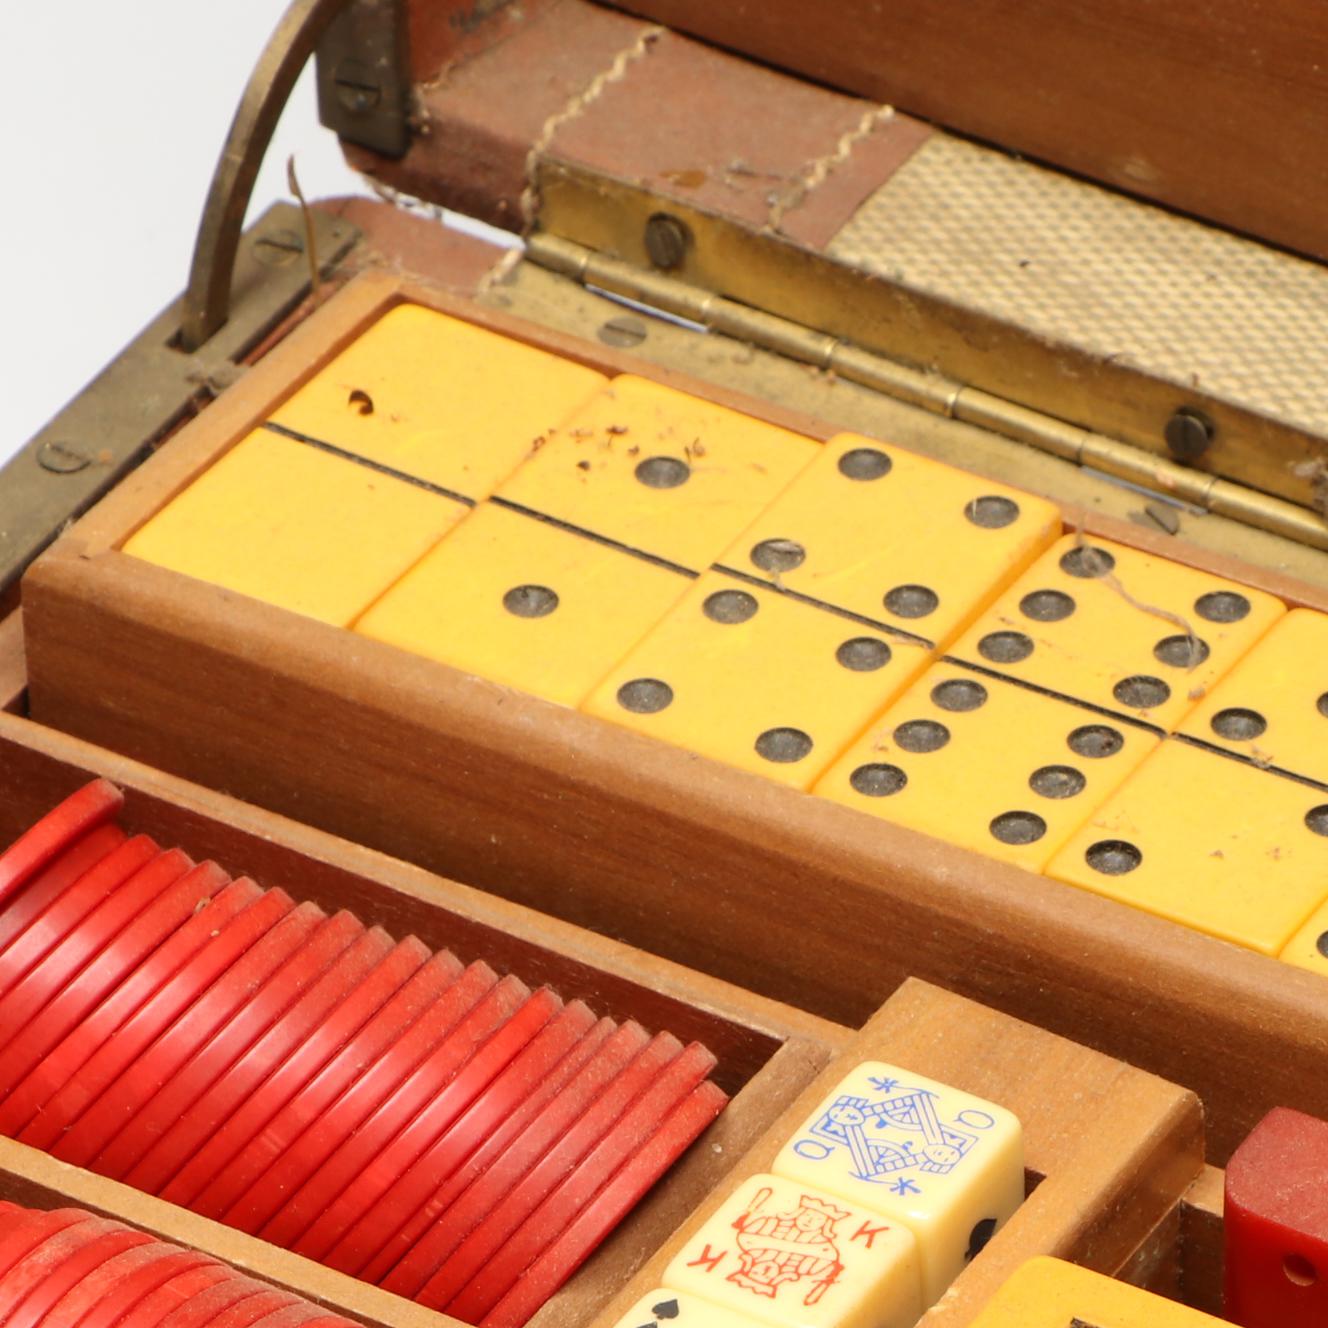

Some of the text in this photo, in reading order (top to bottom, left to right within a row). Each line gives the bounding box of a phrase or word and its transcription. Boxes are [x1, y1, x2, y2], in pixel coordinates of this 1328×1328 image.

[954, 1109, 995, 1130] Q
[793, 1139, 835, 1161] Q
[850, 1219, 890, 1249] K
[686, 1243, 728, 1273] K
